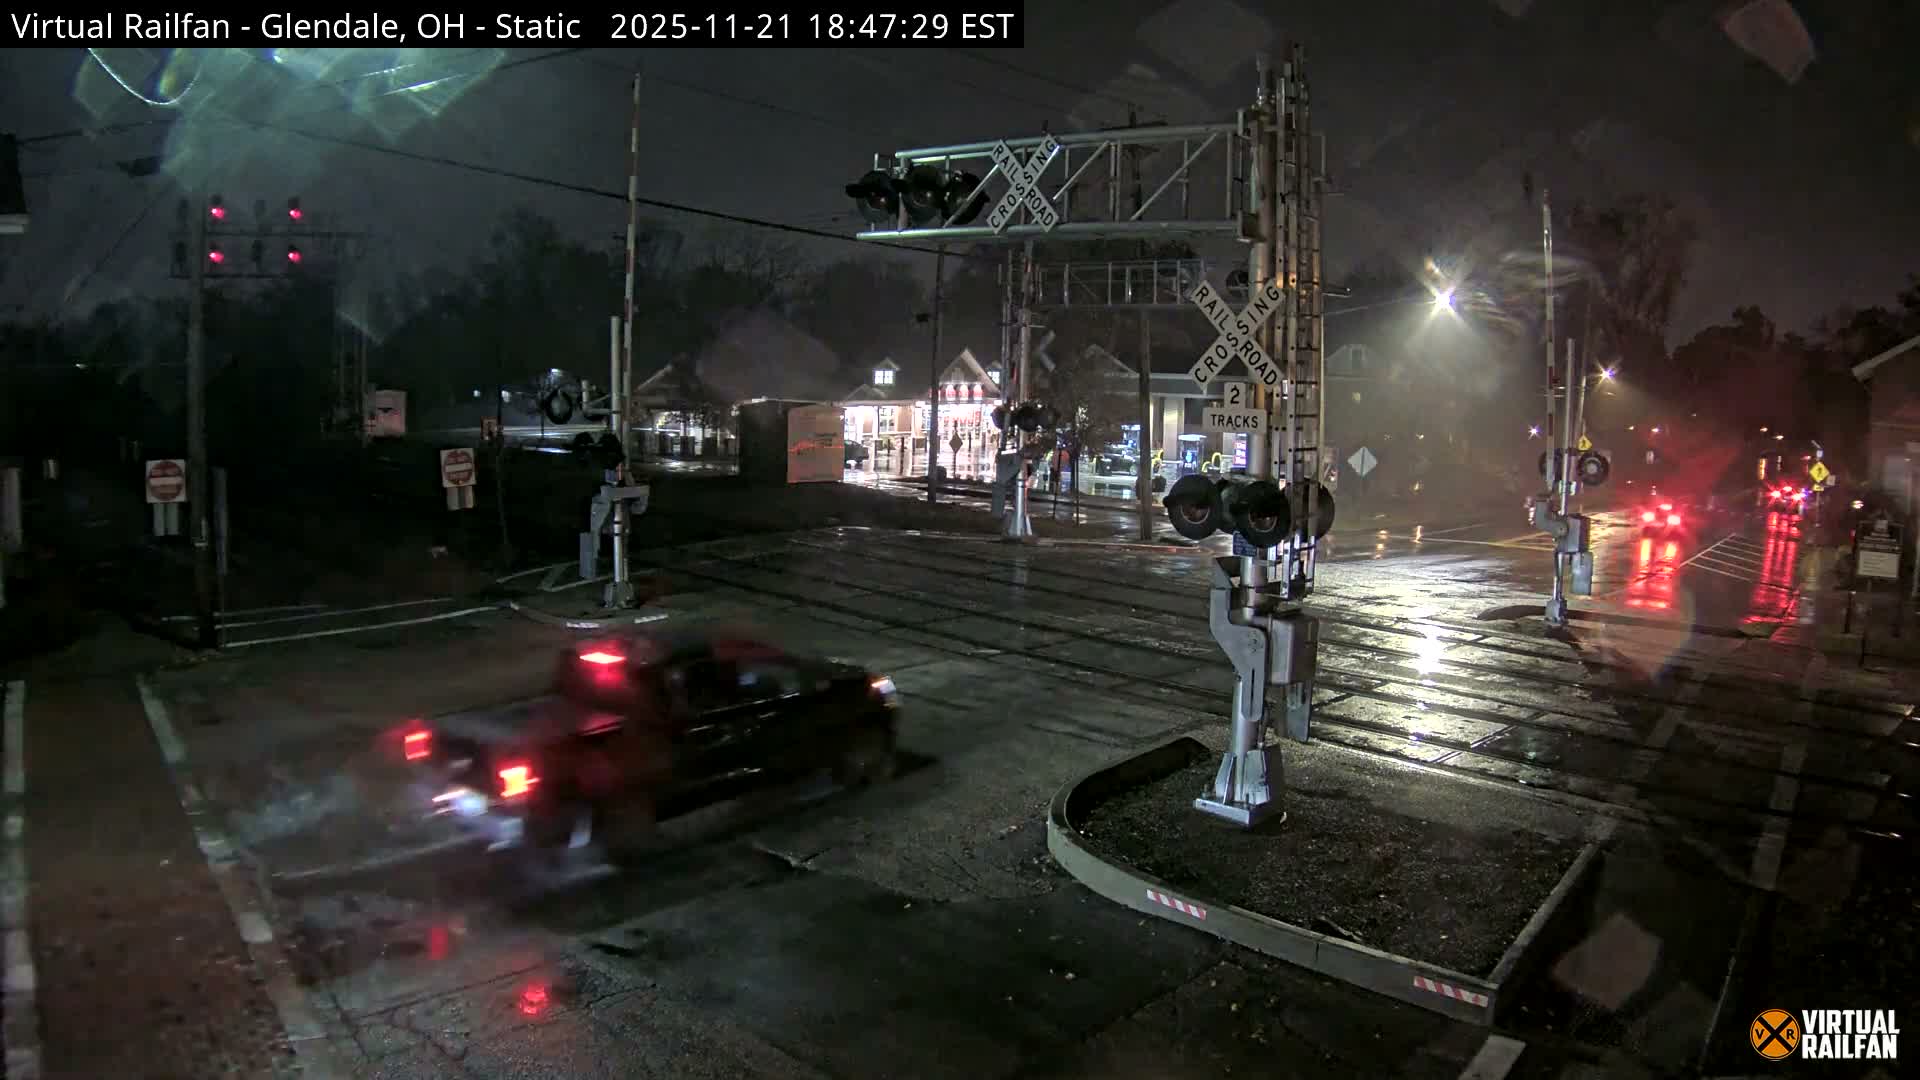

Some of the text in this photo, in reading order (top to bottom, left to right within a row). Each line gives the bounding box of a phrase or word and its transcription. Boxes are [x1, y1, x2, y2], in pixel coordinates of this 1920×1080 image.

[991, 140, 1056, 228] CROSSING
[1194, 286, 1280, 383] CROSSING
[1210, 414, 1259, 429] TRACKS
[1230, 386, 1240, 404] 2
